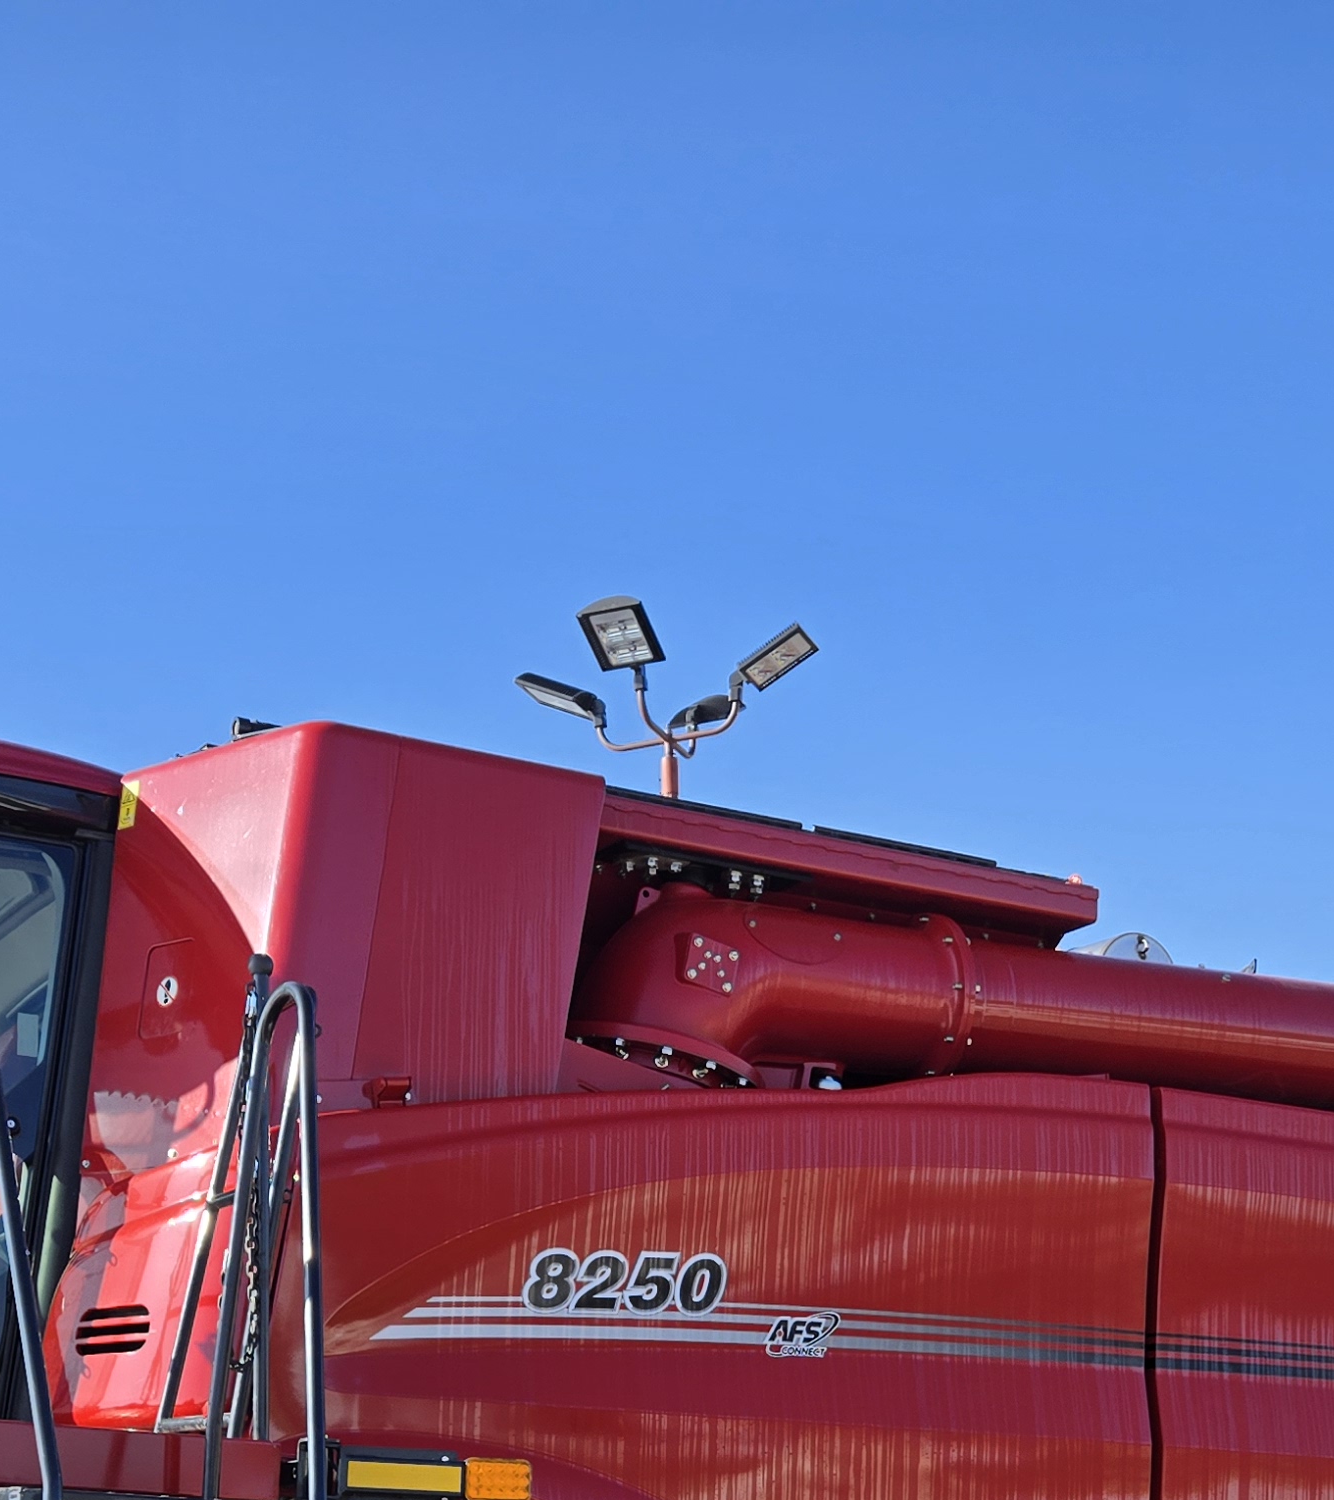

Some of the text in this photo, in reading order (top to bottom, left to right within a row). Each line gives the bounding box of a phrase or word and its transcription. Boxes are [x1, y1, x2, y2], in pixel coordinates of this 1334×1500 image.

[522, 1248, 727, 1316] 8250
[768, 1319, 823, 1343] AFS
[781, 1346, 825, 1356] CONNECT
